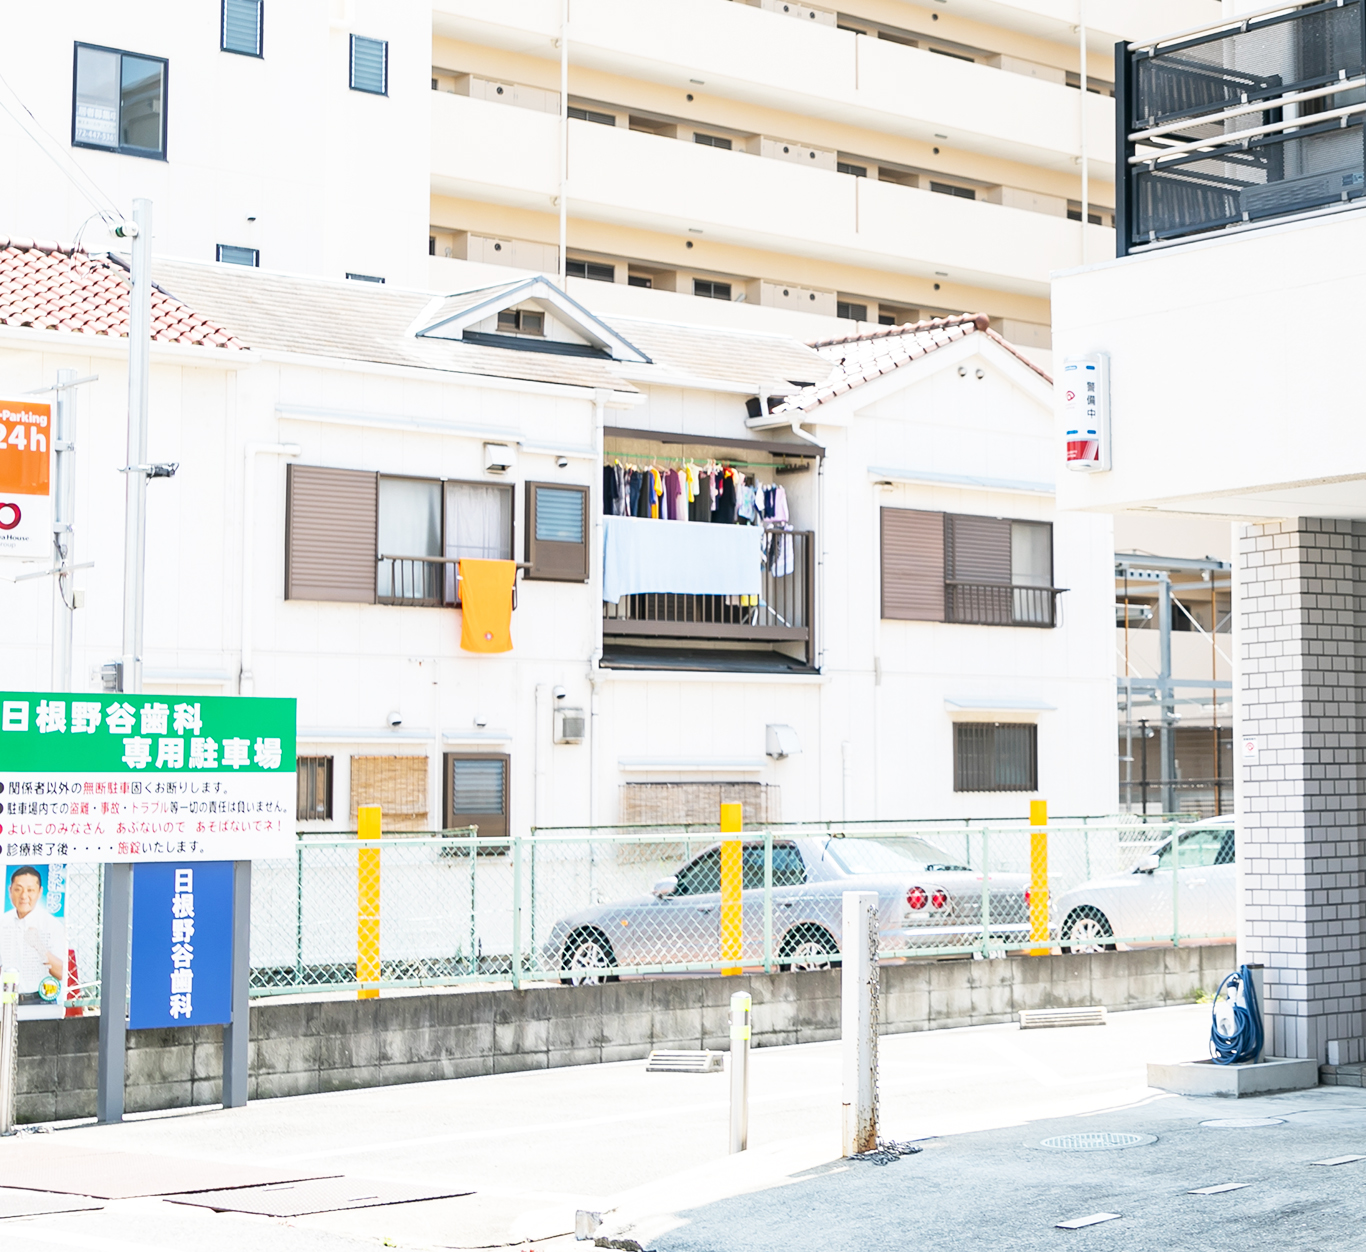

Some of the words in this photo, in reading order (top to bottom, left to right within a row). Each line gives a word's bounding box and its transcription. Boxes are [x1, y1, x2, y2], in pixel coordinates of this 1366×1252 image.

[2, 700, 203, 735] 日根野谷歯科
[121, 736, 282, 769] 専用駐車場
[8, 823, 105, 835] よいこのみなさん
[116, 821, 185, 834] あぶないので
[170, 869, 195, 1019] 日根野谷歯科
